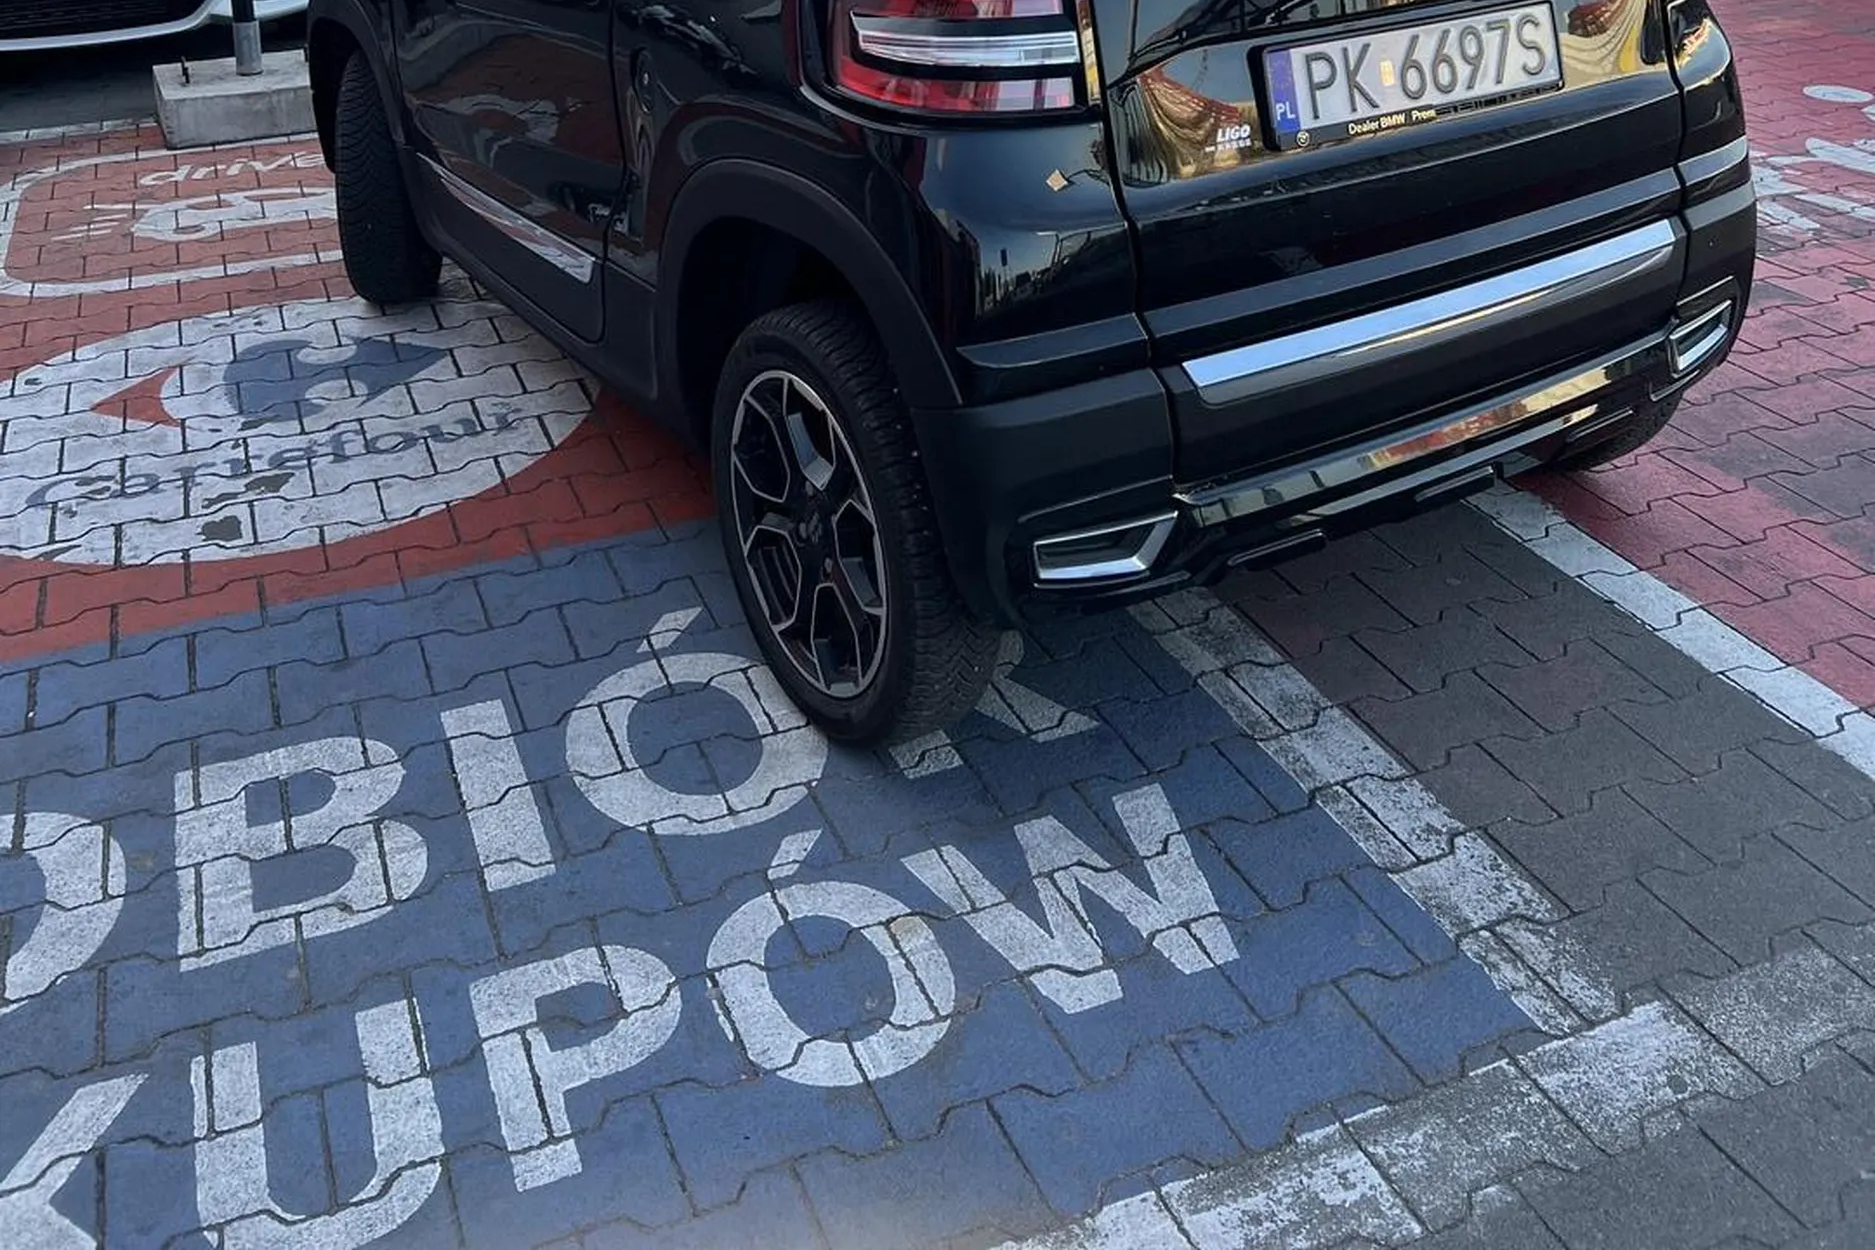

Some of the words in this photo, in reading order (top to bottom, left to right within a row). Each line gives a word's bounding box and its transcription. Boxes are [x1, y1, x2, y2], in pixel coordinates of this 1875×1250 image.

[1304, 41, 1381, 121] PK
[1399, 12, 1547, 101] 6697S
[1275, 102, 1297, 121] PL
[1348, 119, 1380, 136] Dealer
[1379, 112, 1406, 130] BMW
